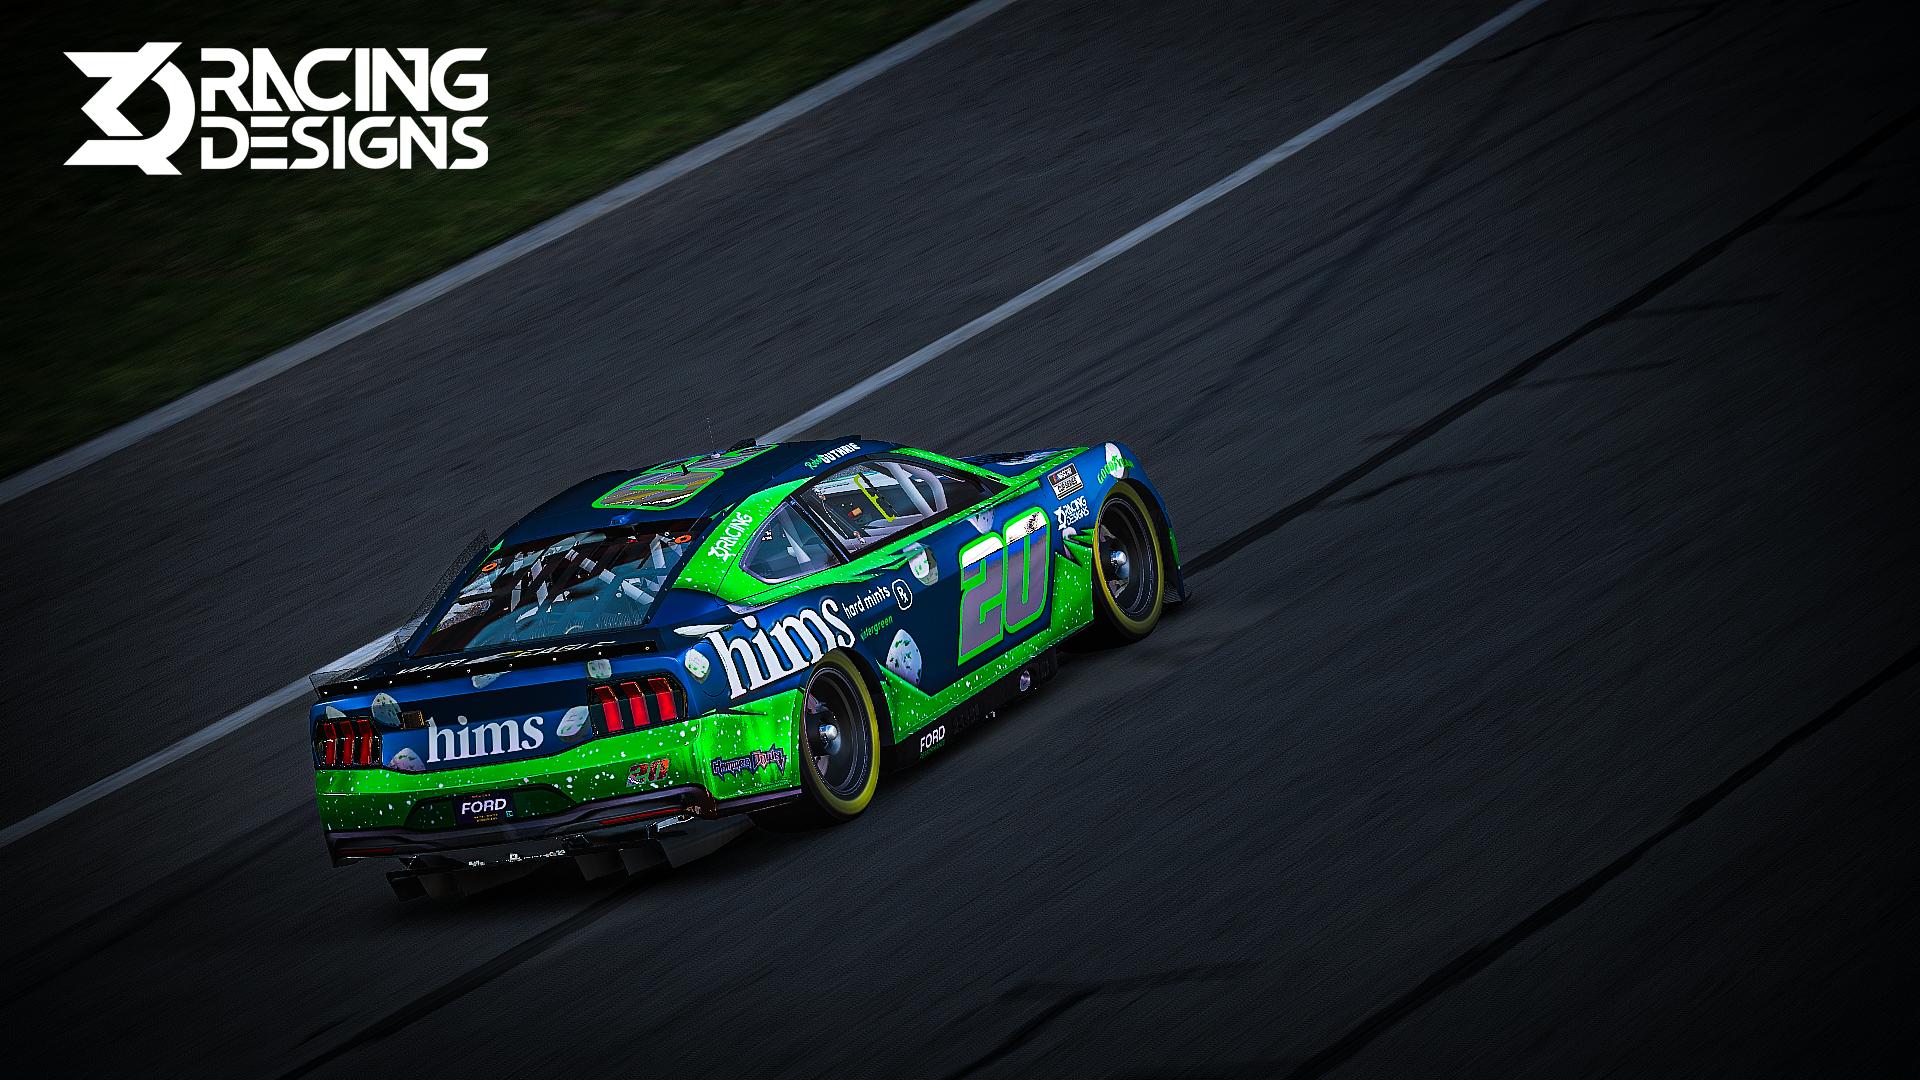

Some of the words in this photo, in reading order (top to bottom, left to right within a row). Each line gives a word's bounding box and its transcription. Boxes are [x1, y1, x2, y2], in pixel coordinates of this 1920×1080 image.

[715, 512, 753, 551] RACING
[842, 595, 865, 620] hard
[863, 586, 891, 609] mints
[958, 506, 1051, 667] 20
[703, 598, 856, 700] hims
[426, 714, 545, 764] hims
[920, 725, 946, 753] FORD
[626, 758, 669, 788] 20
[461, 798, 507, 815] FORD
